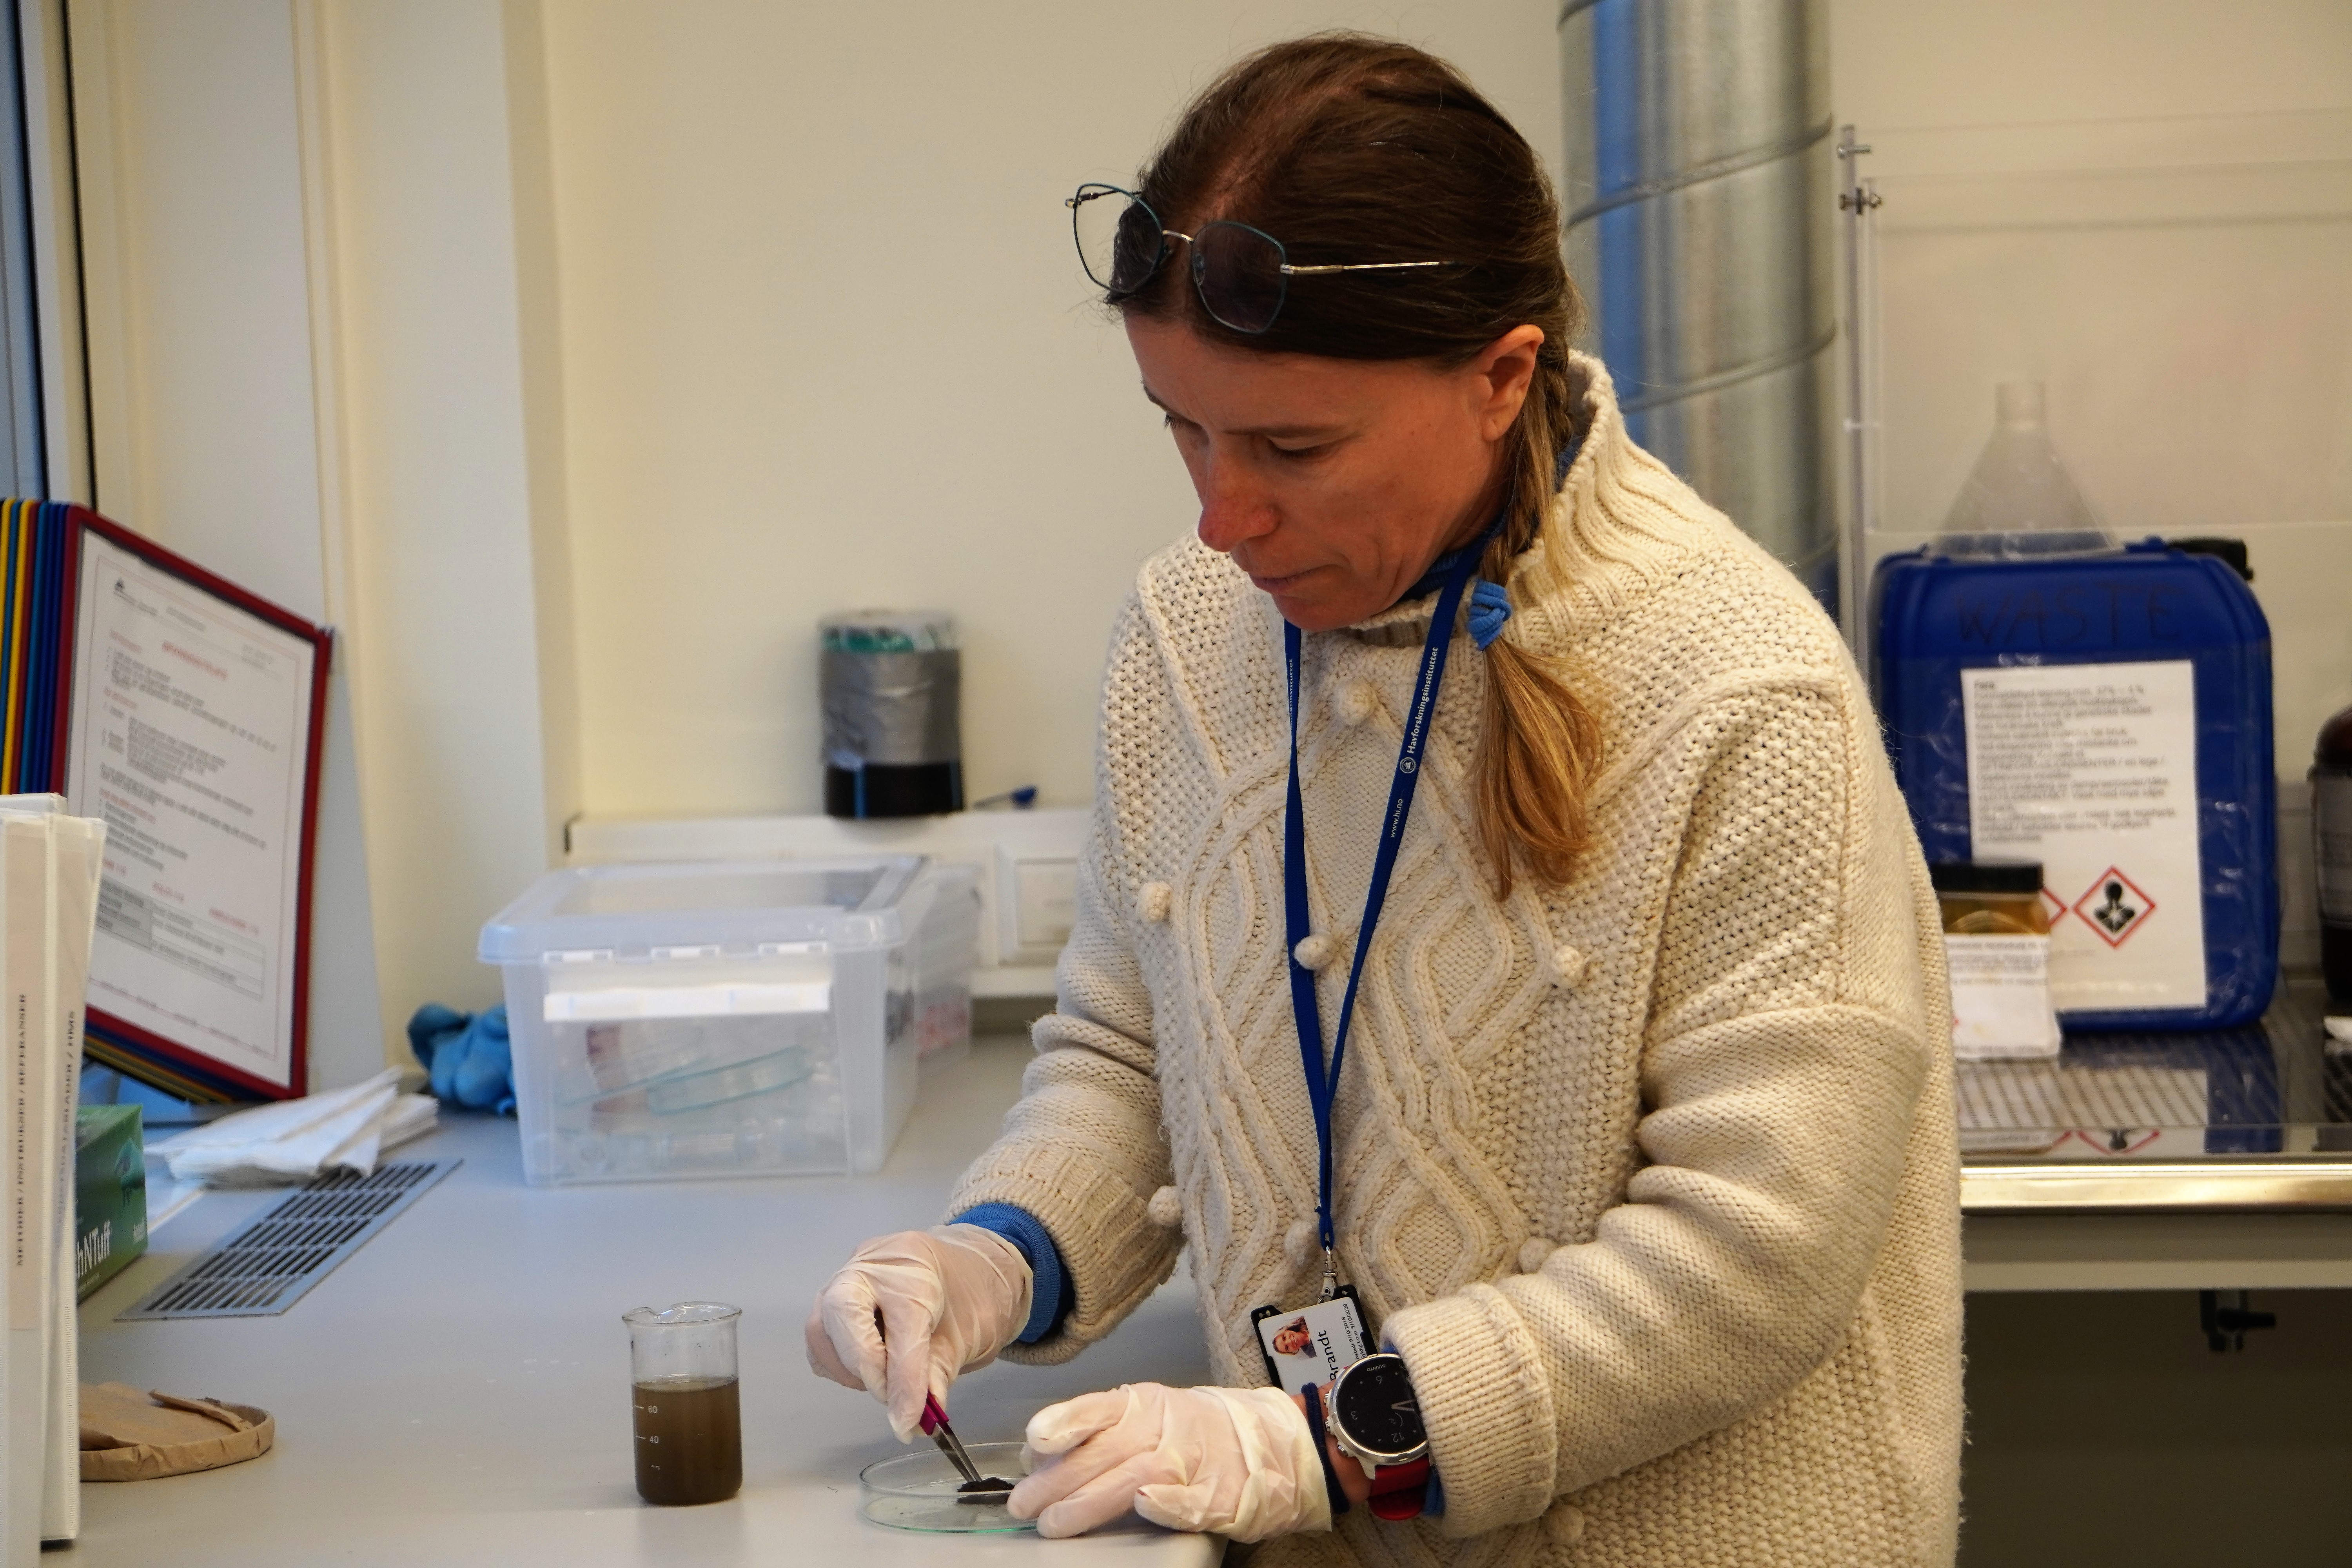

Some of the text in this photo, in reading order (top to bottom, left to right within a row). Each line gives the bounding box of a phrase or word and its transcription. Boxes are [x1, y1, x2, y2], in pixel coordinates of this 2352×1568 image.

[1953, 581, 2187, 646] WASTE
[1407, 647, 1438, 754] Havforskningsinstituttet
[1390, 799, 1403, 838] www.hi.no
[1341, 1317, 1353, 1342] 9/10/2018
[1343, 1303, 1355, 1329] 9/10/2028
[1317, 1330, 1338, 1381] Brandt
